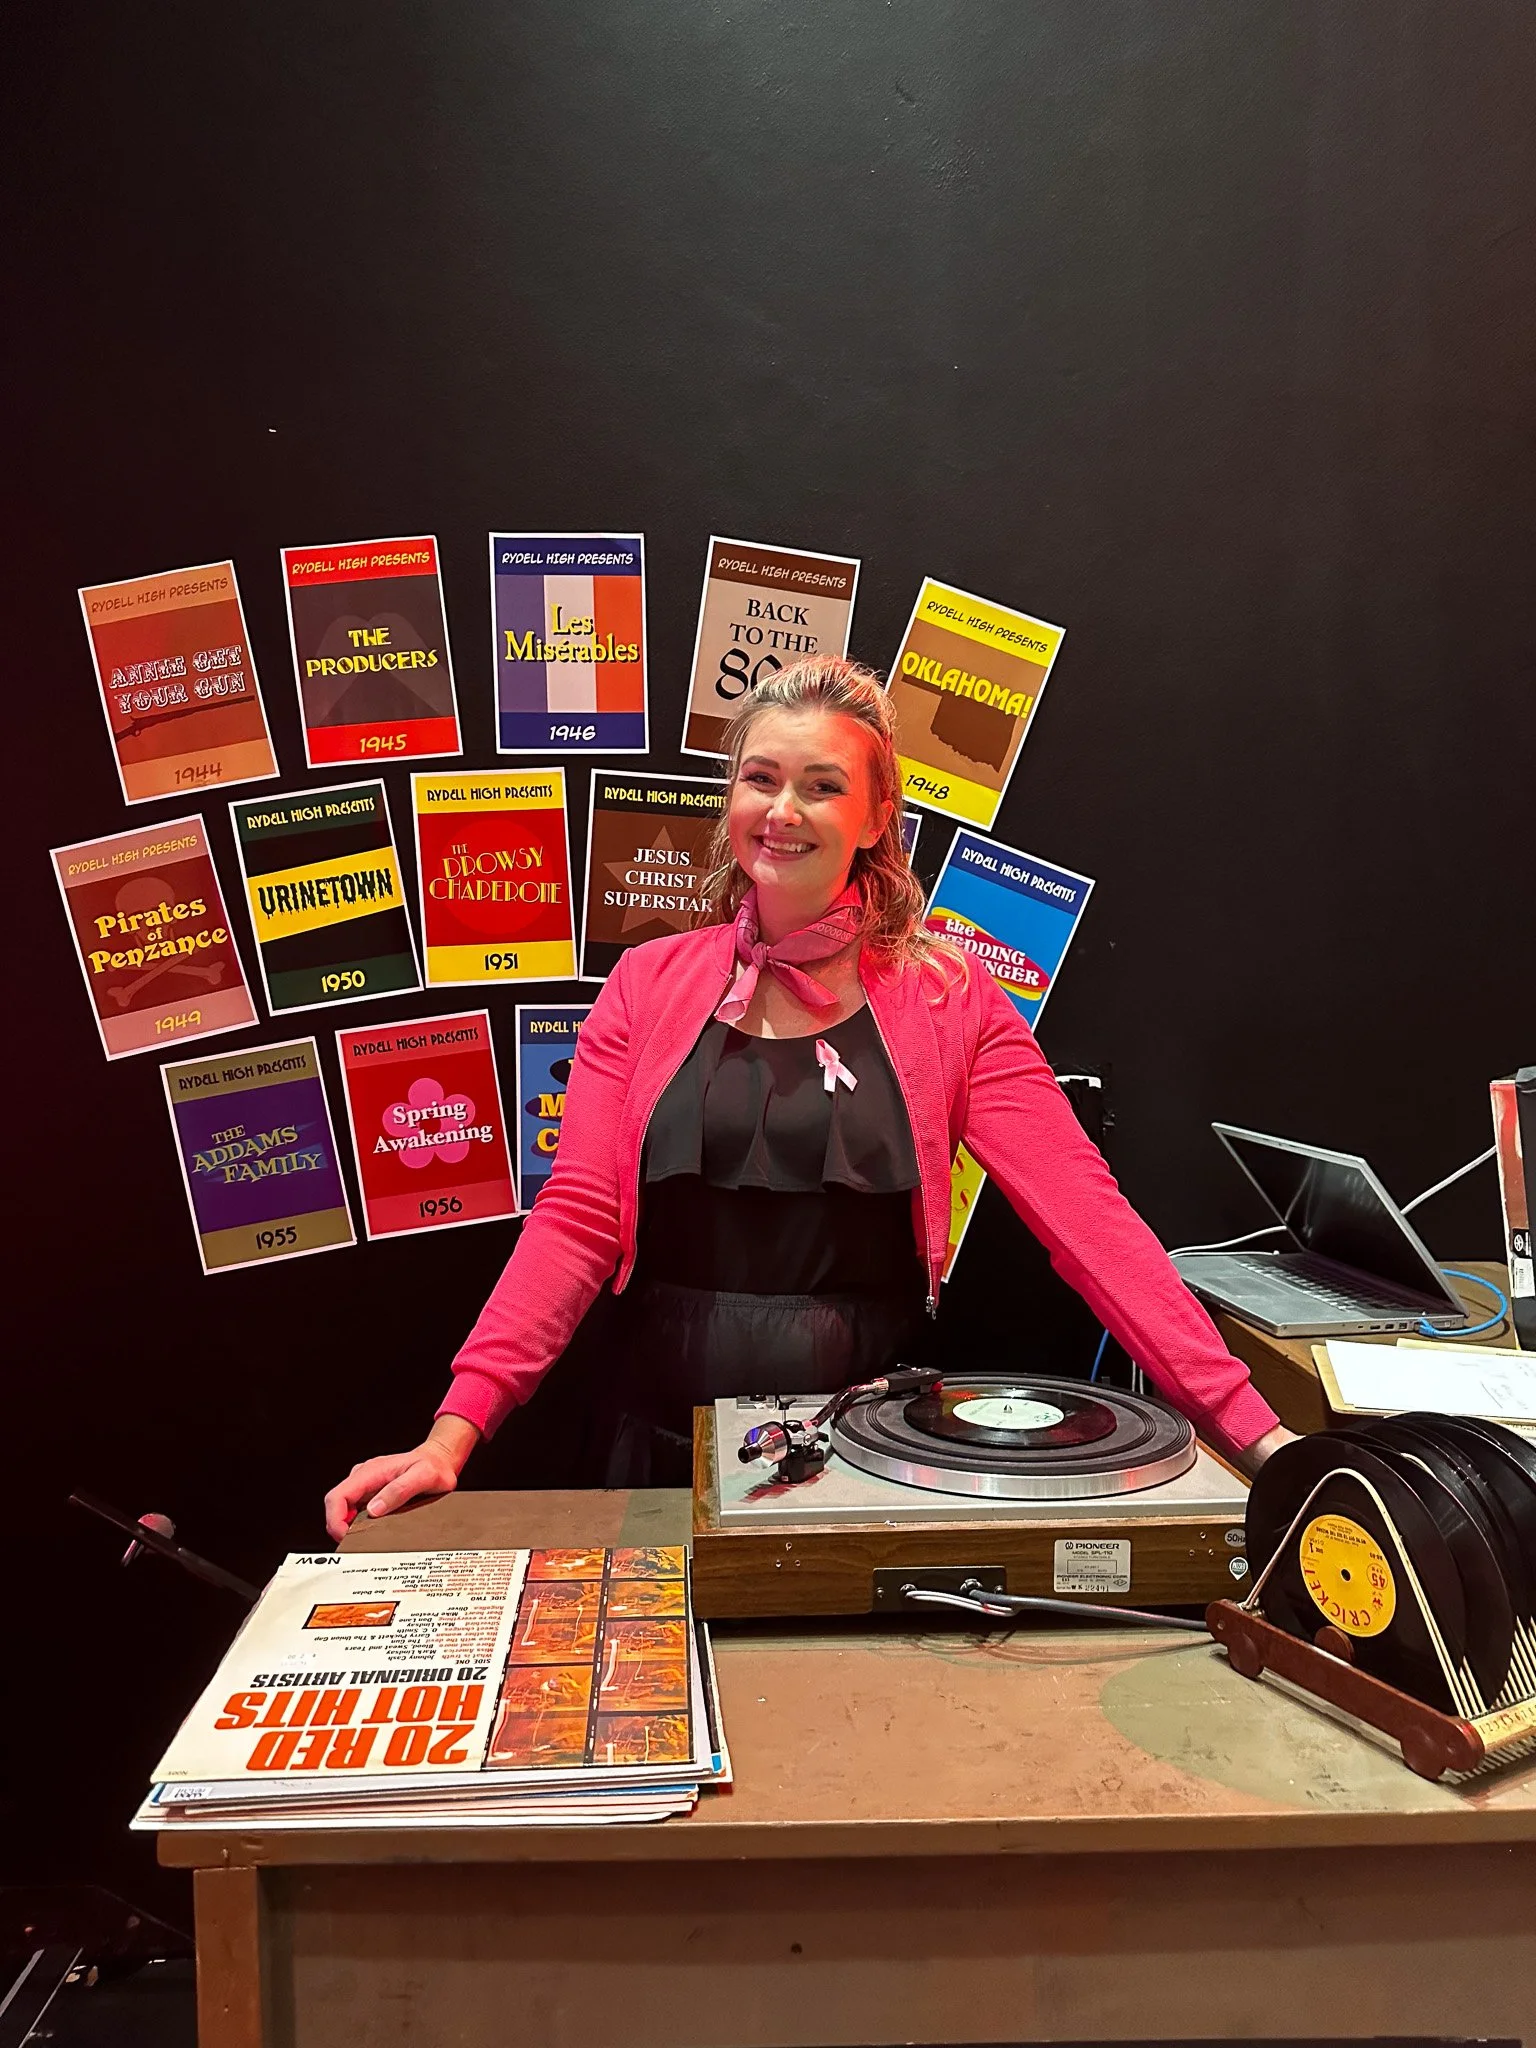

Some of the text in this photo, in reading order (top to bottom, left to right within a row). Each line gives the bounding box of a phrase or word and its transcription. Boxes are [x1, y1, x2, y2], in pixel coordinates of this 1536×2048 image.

[292, 551, 430, 575] RYDELL HIGH PRESENTS
[502, 552, 634, 565] RYDELL HIGH PRESENTS
[718, 558, 847, 589] RYDELL HIGH PRESENTS
[92, 577, 229, 613] RYDELL HIGH PRESENTS
[550, 603, 594, 636] Les
[746, 598, 810, 625] BACK
[348, 627, 391, 648] THE
[729, 623, 817, 655] TO THE
[926, 601, 1048, 653] RYDELL HIGH PRESENTS
[504, 630, 640, 663] Misérables
[109, 645, 242, 689] ANNIE GET
[306, 649, 438, 677] PRODUCERS
[115, 672, 245, 714] YOUR GUN
[901, 651, 1034, 719] OKLAHOMA!
[360, 734, 406, 753] 1945
[549, 725, 596, 741] 1946
[175, 762, 222, 784] 1944
[426, 784, 553, 802] RYDELL HIGH PRESENTS
[604, 786, 727, 809] RYDELL HIGH PRESENTS
[906, 774, 950, 800] 1948
[246, 797, 375, 829] RYDELL HIGH PRESENTS
[68, 835, 198, 876] RYDELL HIGH PRESENTS
[442, 845, 544, 879] DROWSY
[451, 843, 468, 855] THE
[633, 848, 691, 866] JESUS
[624, 871, 697, 889] CHRIST
[961, 847, 1076, 903] RYDELL HIGH PRESENTS
[257, 867, 394, 920] URINETOWN
[428, 878, 563, 904] CHAPERONE
[604, 890, 713, 913] SUPERSTAR
[94, 898, 207, 939] Pirates
[945, 917, 976, 938] the
[147, 927, 163, 942] of
[88, 927, 229, 974] Penzance
[484, 953, 518, 971] 1951
[321, 969, 366, 993] 1950
[983, 959, 1040, 987] NGER
[154, 1010, 201, 1035] 1949
[530, 1021, 569, 1033] RYDELL
[353, 1027, 479, 1057] RYDELL HIGH PRESENTS
[178, 1055, 306, 1091] RYDELL HIGH PRESENTS
[392, 1100, 468, 1129] Spring
[211, 1124, 246, 1145] THE
[373, 1122, 493, 1156] Awakening
[191, 1125, 298, 1175] ADDAMS
[222, 1151, 322, 1184] FAMILY
[418, 1196, 463, 1218] 1956
[255, 1226, 297, 1251] 1955
[296, 1556, 341, 1566] NOW
[1371, 1572, 1386, 1588] 45
[1303, 1566, 1371, 1627] CRICKET
[250, 1667, 489, 1688] 20 ORIGINAL ARTISTS
[214, 1684, 485, 1730] HOT HITS
[246, 1725, 474, 1771] 20 RED
